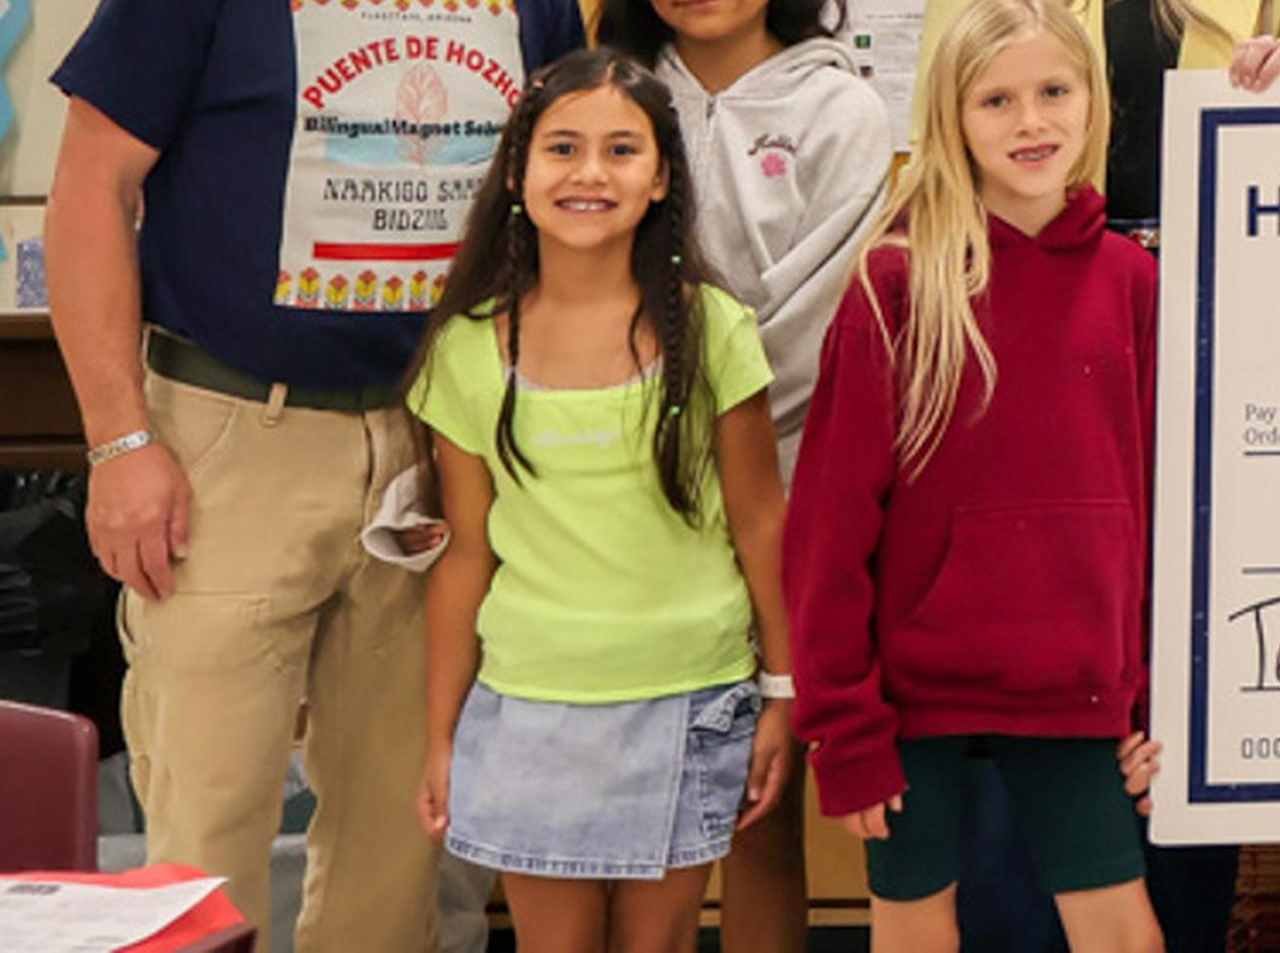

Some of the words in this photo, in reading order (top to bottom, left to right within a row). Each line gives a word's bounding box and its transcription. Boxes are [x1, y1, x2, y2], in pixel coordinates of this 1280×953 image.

[302, 36, 400, 110] PUENTE
[405, 34, 440, 60] DE
[304, 115, 391, 139] Bilingual
[391, 119, 461, 139] Magnet
[1245, 402, 1277, 424] Pay
